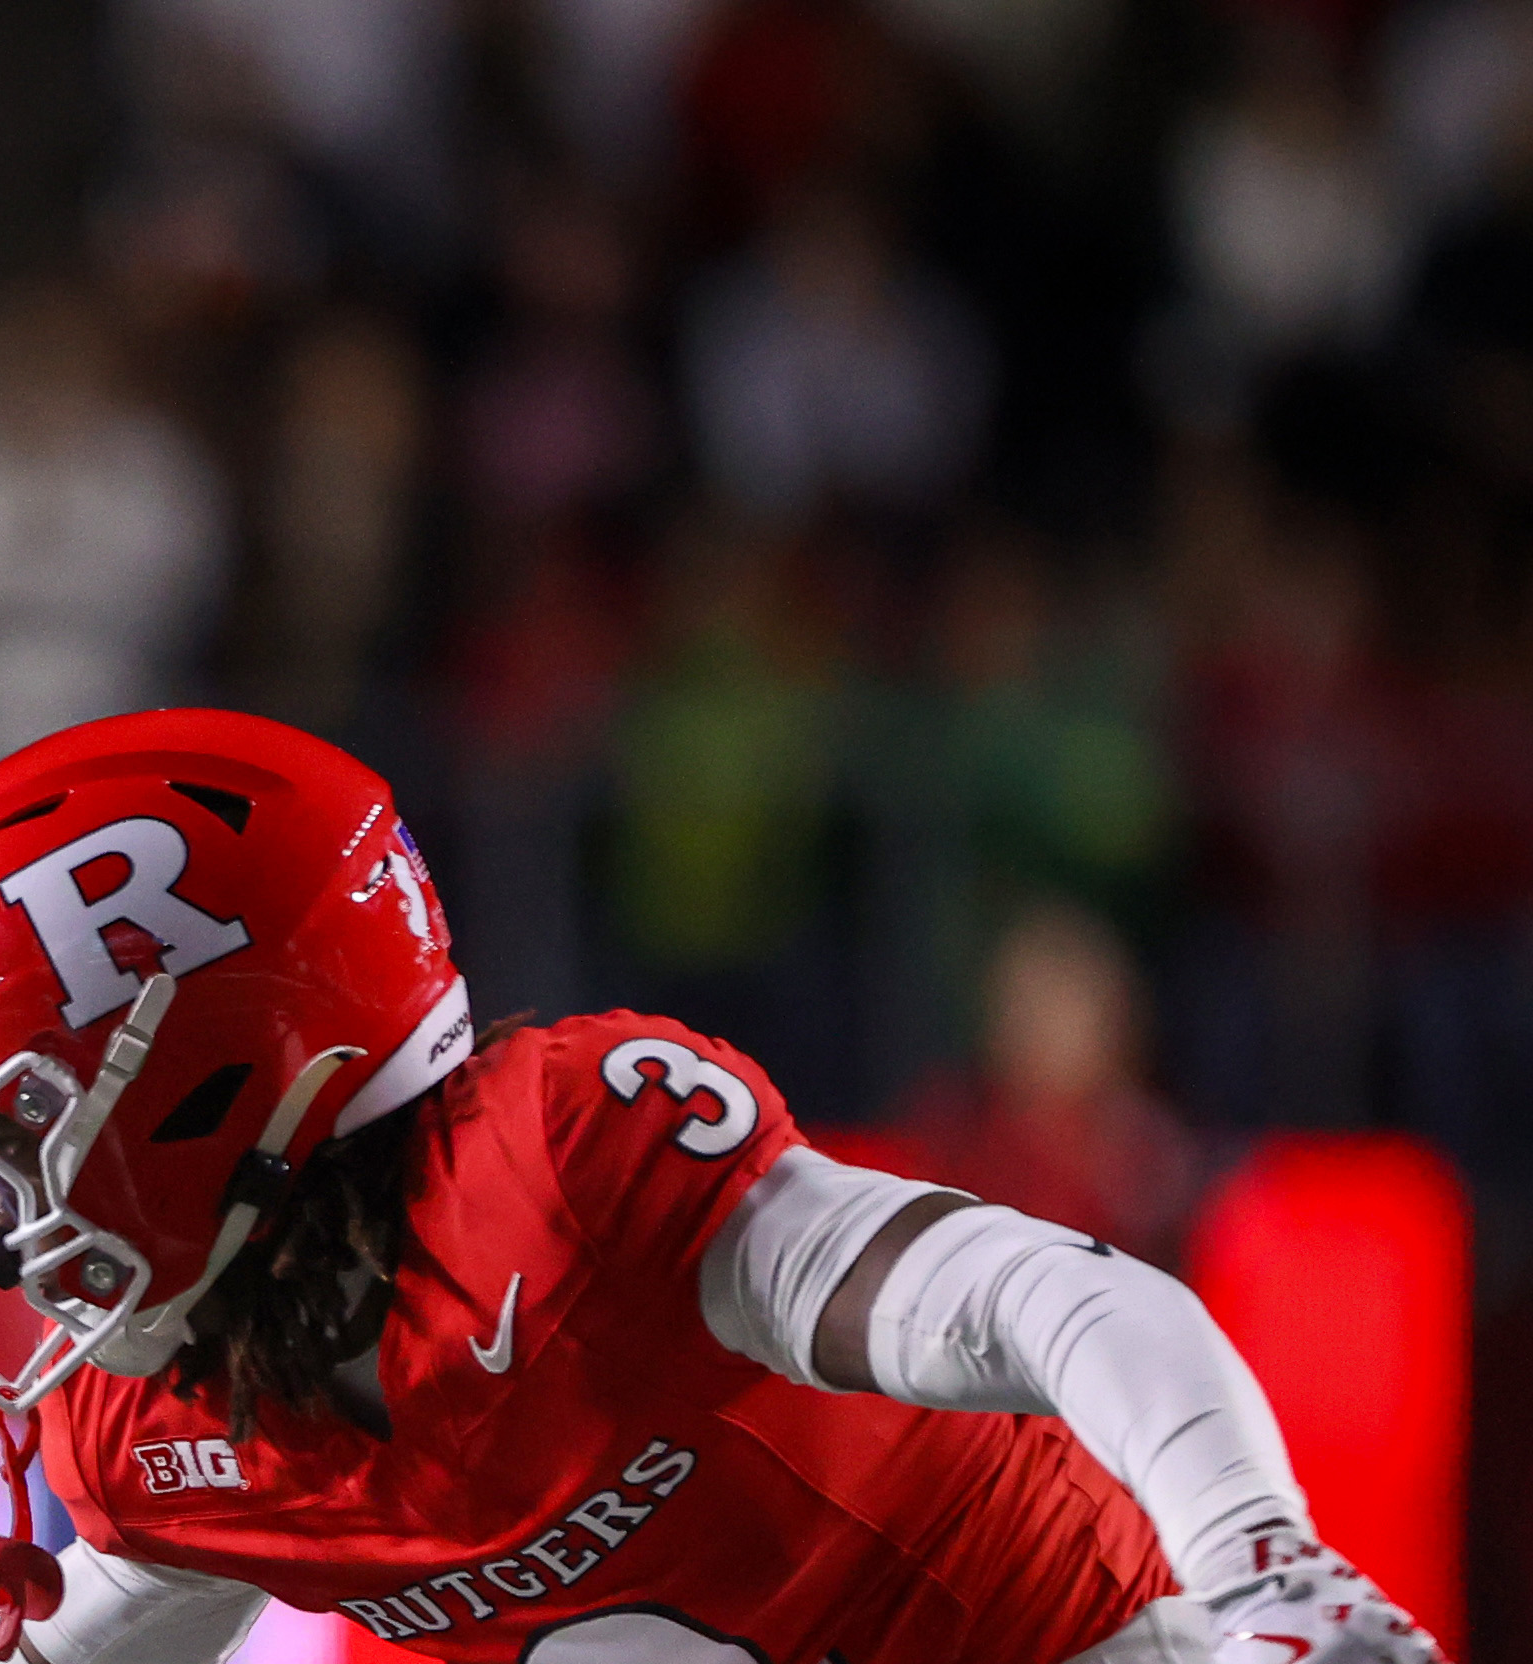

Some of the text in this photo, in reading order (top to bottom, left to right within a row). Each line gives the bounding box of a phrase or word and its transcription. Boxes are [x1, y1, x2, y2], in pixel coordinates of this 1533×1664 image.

[600, 1035, 761, 1163] 3
[131, 1438, 245, 1496] BIG
[337, 1436, 699, 1642] RUTGERS
